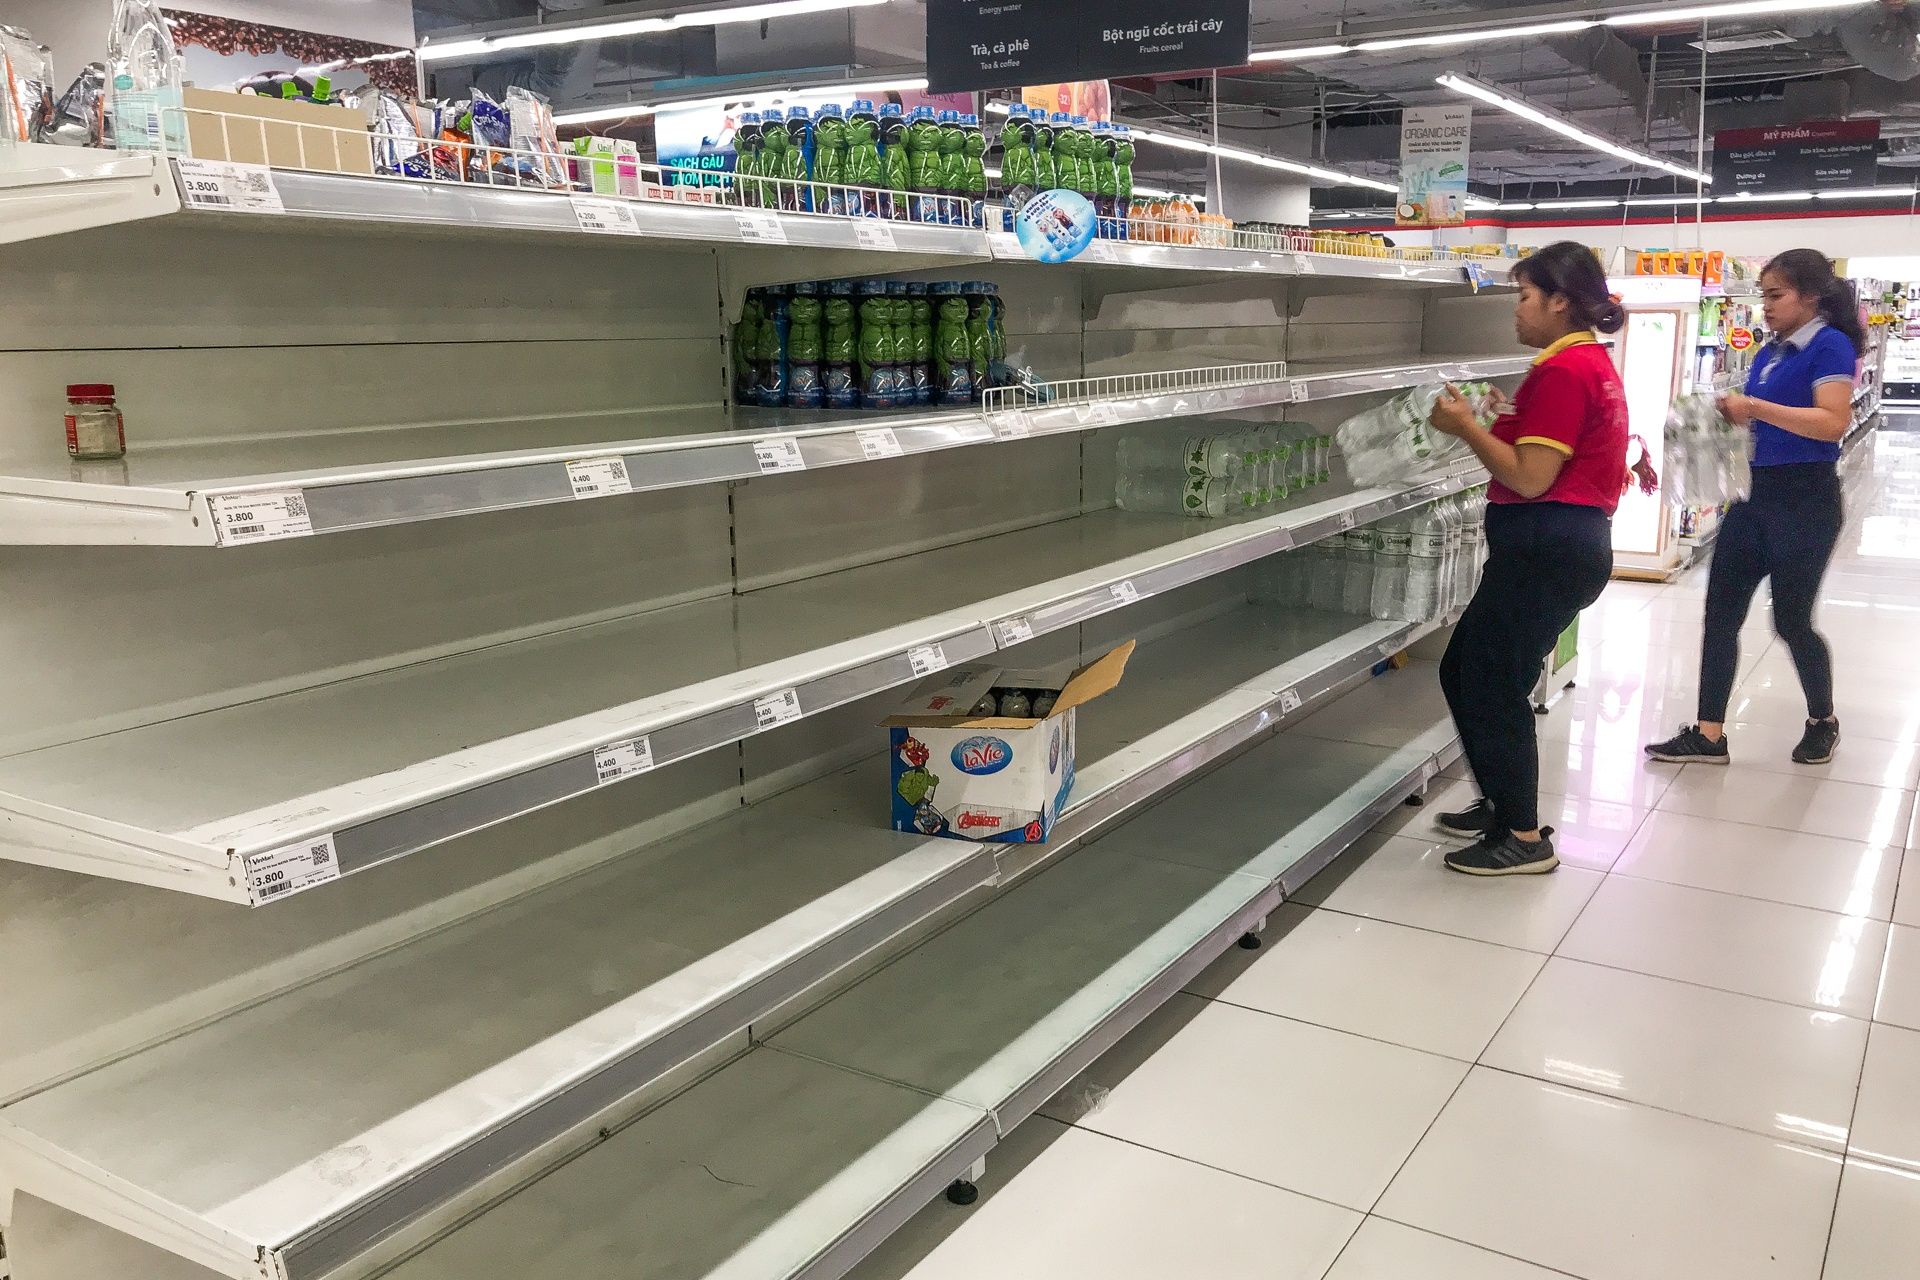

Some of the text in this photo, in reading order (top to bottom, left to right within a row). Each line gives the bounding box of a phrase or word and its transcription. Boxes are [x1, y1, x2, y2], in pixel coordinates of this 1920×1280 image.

[979, 3, 1022, 15] Energy water
[1102, 18, 1224, 43] Bột ngũ cốc trái cây
[971, 39, 1030, 56] Trà, cà phê
[1139, 42, 1184, 54] Fruits cereal
[980, 59, 1020, 70] Tea & coffee
[1404, 125, 1467, 139] ORGANIC CARE
[701, 153, 725, 169] GÀU
[186, 180, 219, 192] 3.800
[578, 212, 597, 220] 4.200
[756, 452, 773, 460] 8.400
[572, 474, 591, 483] 4.400
[226, 511, 254, 523] 3.800
[757, 707, 772, 718] 8.400
[597, 757, 617, 769] 4.400
[251, 854, 274, 865] VinMart
[255, 870, 284, 887] 3.800
